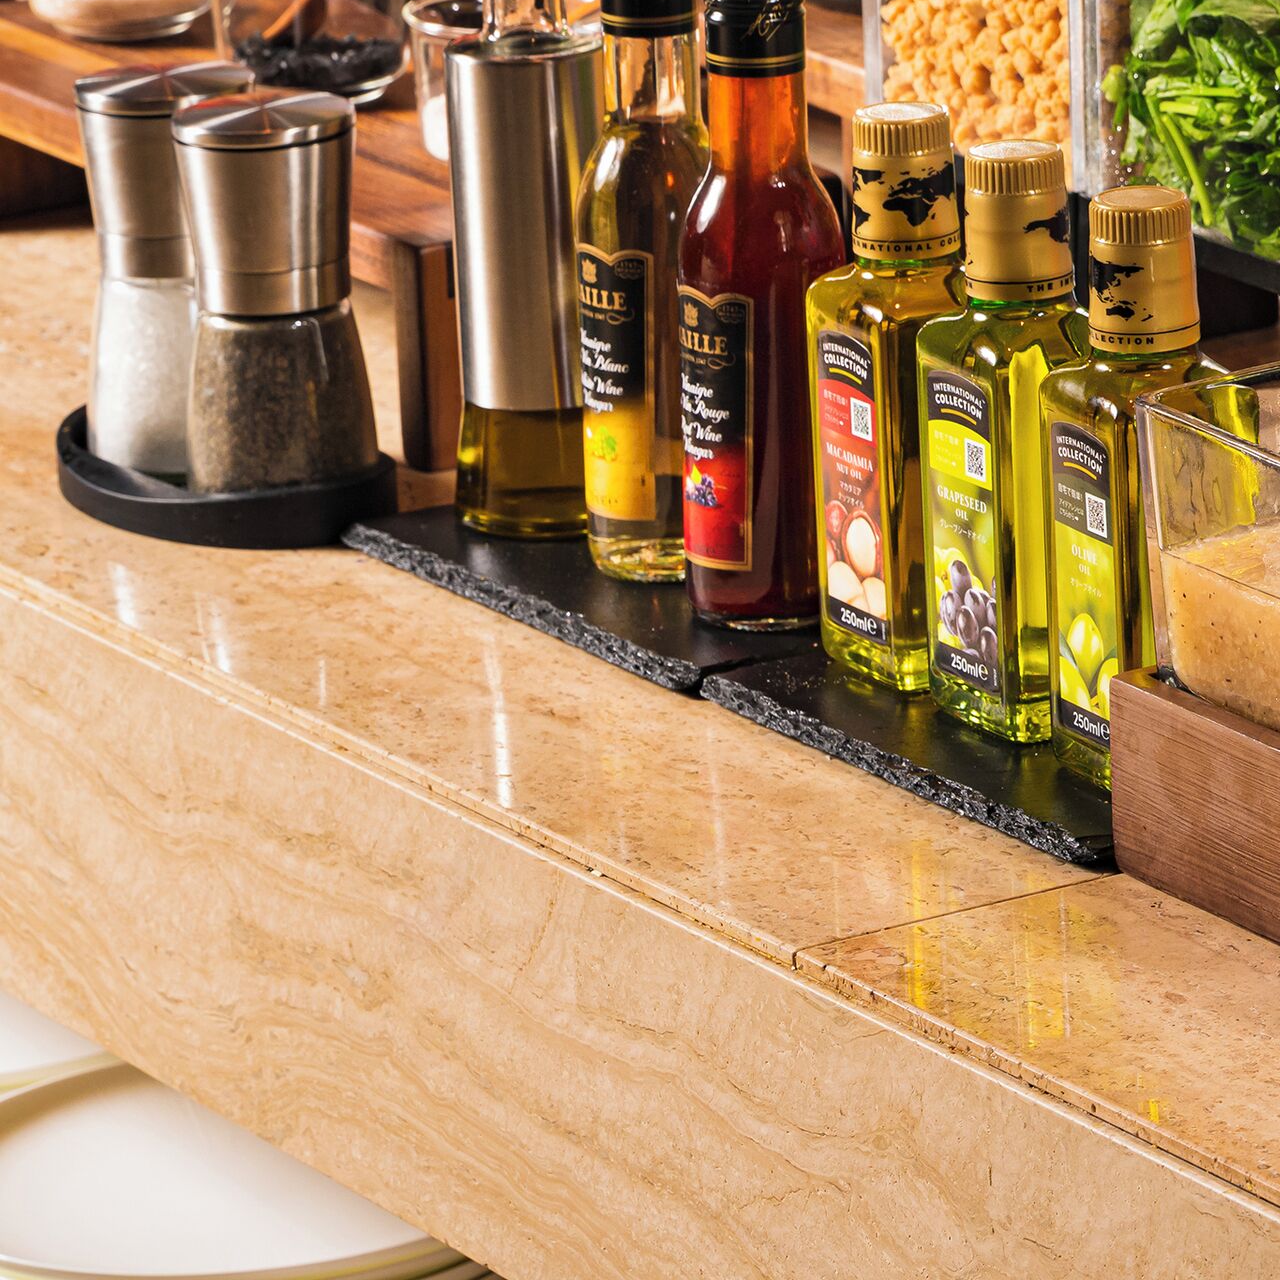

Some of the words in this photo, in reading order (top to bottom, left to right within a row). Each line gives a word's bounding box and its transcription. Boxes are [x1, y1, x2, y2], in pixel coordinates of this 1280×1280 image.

[579, 283, 627, 312] AILLE
[1027, 282, 1053, 293] THE
[679, 324, 729, 356] AILLE
[824, 353, 867, 380] COLLECTION
[932, 382, 982, 409] INTERNATIONAL
[934, 393, 982, 421] COLLECTION
[692, 400, 731, 424] Rouge
[692, 421, 723, 443] Wine
[826, 441, 873, 473] MACADAMIA
[1056, 435, 1103, 463] INTERNATIONAL
[1058, 446, 1103, 475] COLLECTION
[836, 462, 848, 476] NUT
[850, 468, 863, 481] OIL
[937, 484, 987, 514] GRAPESEED
[955, 508, 969, 521] OIL
[1071, 543, 1098, 566] OLIVE
[1078, 563, 1092, 577] OIL
